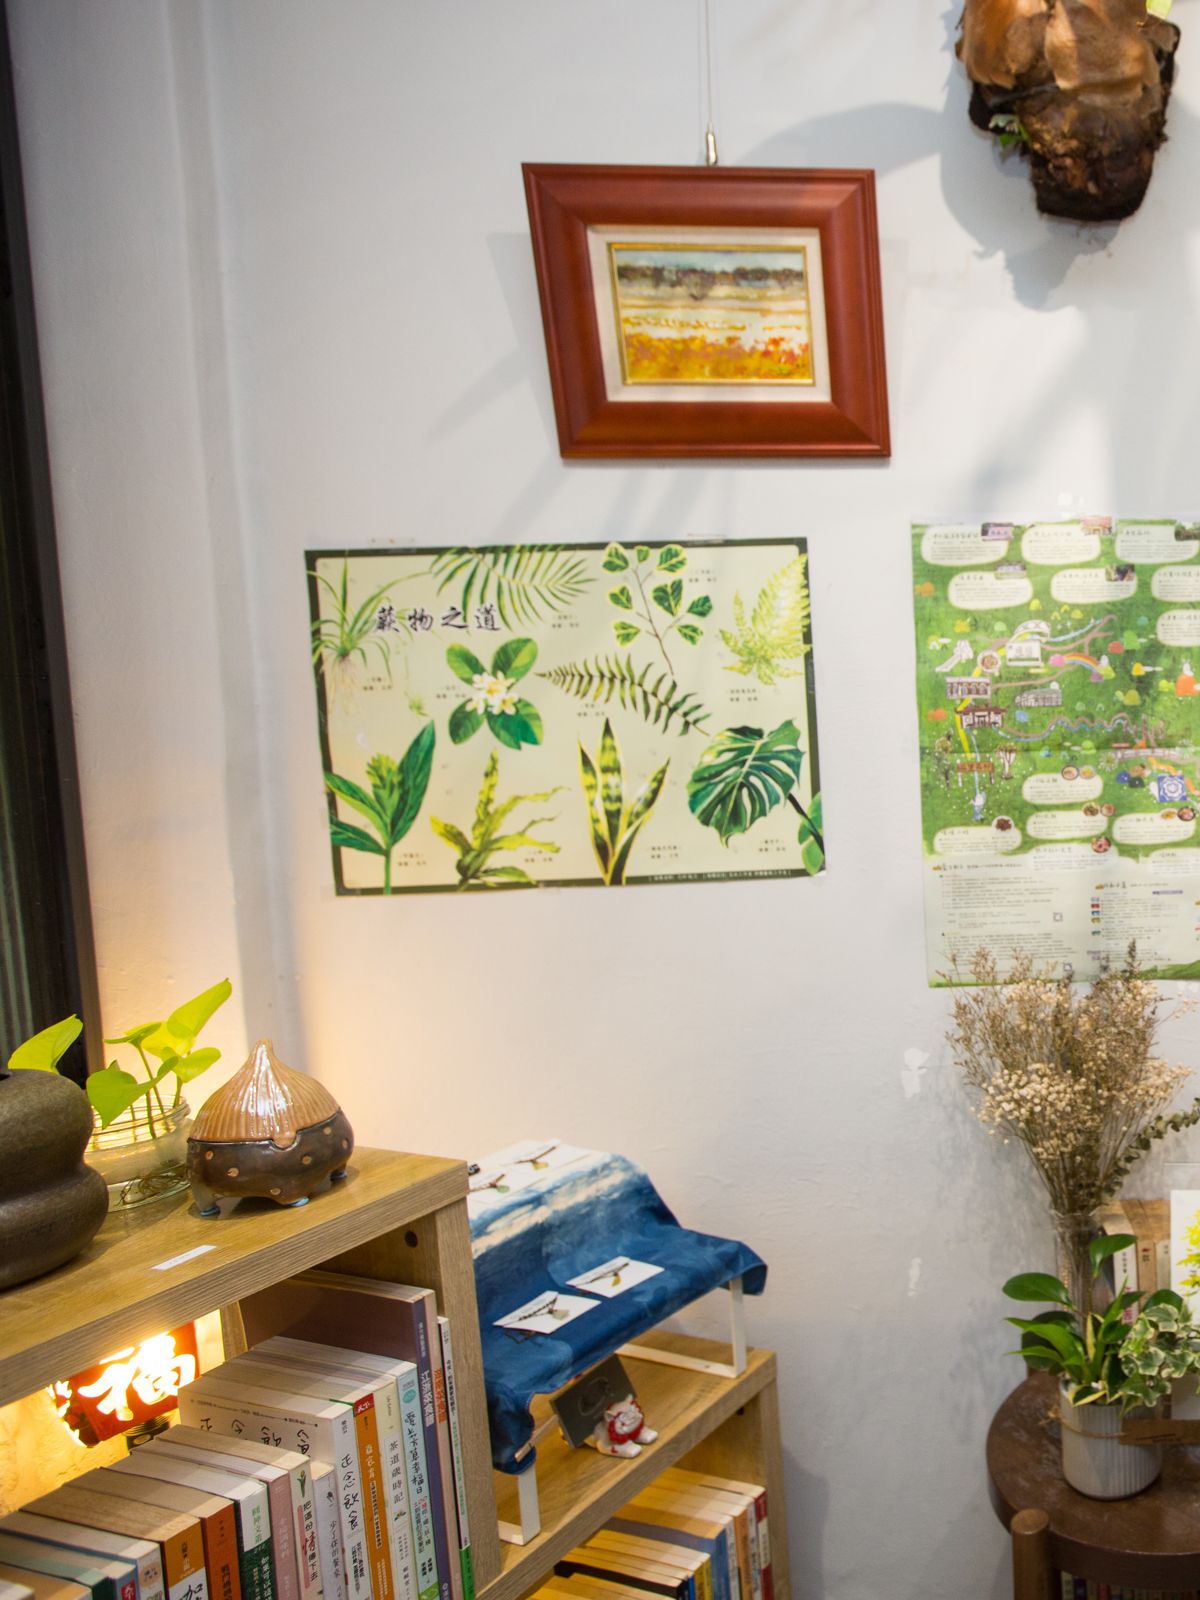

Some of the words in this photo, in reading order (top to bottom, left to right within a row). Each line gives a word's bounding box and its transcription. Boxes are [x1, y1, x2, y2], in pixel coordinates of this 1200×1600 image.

[78, 1331, 195, 1421] 福
[302, 1500, 319, 1582] 把這份情傳下去
